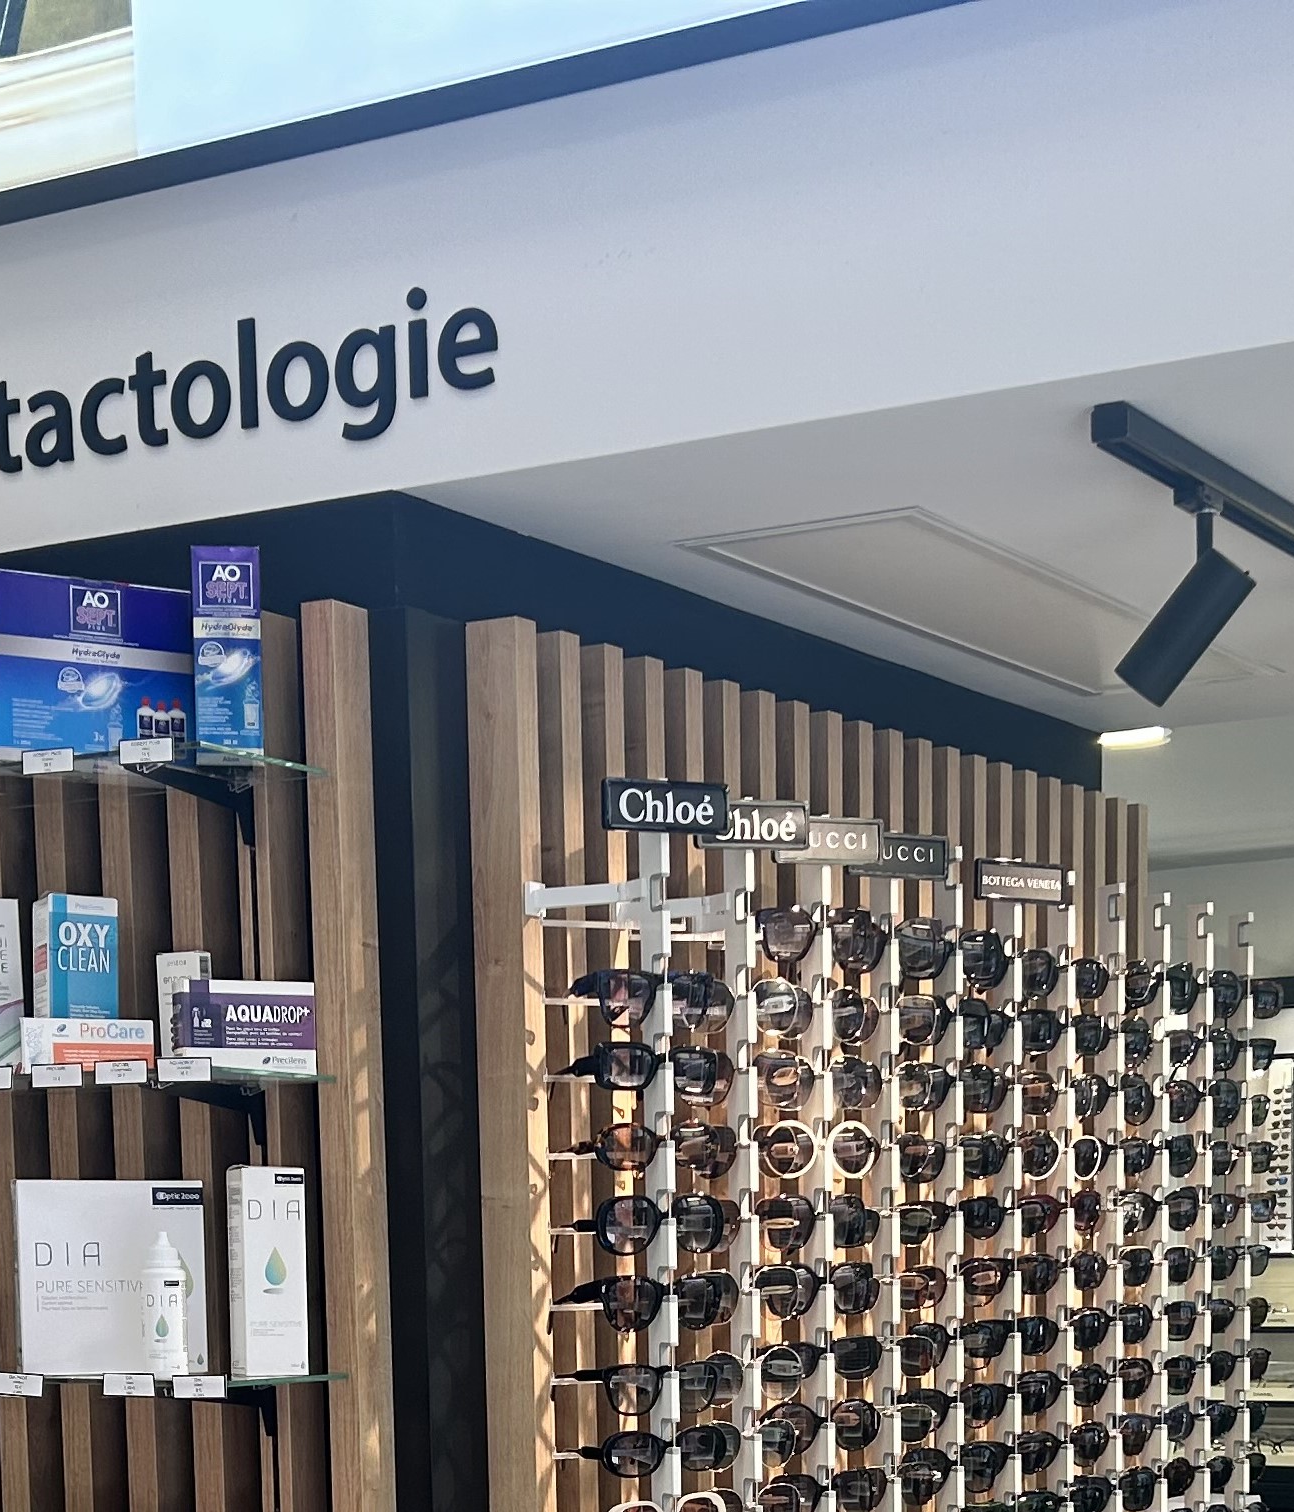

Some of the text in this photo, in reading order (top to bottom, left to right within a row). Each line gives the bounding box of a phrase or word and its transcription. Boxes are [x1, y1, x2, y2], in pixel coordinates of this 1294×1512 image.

[212, 565, 241, 582] AO
[82, 591, 109, 608] AO
[206, 581, 247, 599] SEPT
[76, 606, 116, 626] SEPT
[618, 786, 715, 826] Chloé
[808, 831, 868, 850] UCCI
[882, 844, 934, 863] UCCI
[981, 874, 1062, 892] BOTTEGA VENETA
[58, 921, 110, 948] OXY
[57, 946, 110, 974] CLEAN
[80, 1022, 145, 1039] ProCare
[248, 1199, 301, 1220] DIA
[35, 1242, 101, 1267] DIA
[36, 1280, 73, 1293] PURE
[146, 1294, 178, 1307] DIA
